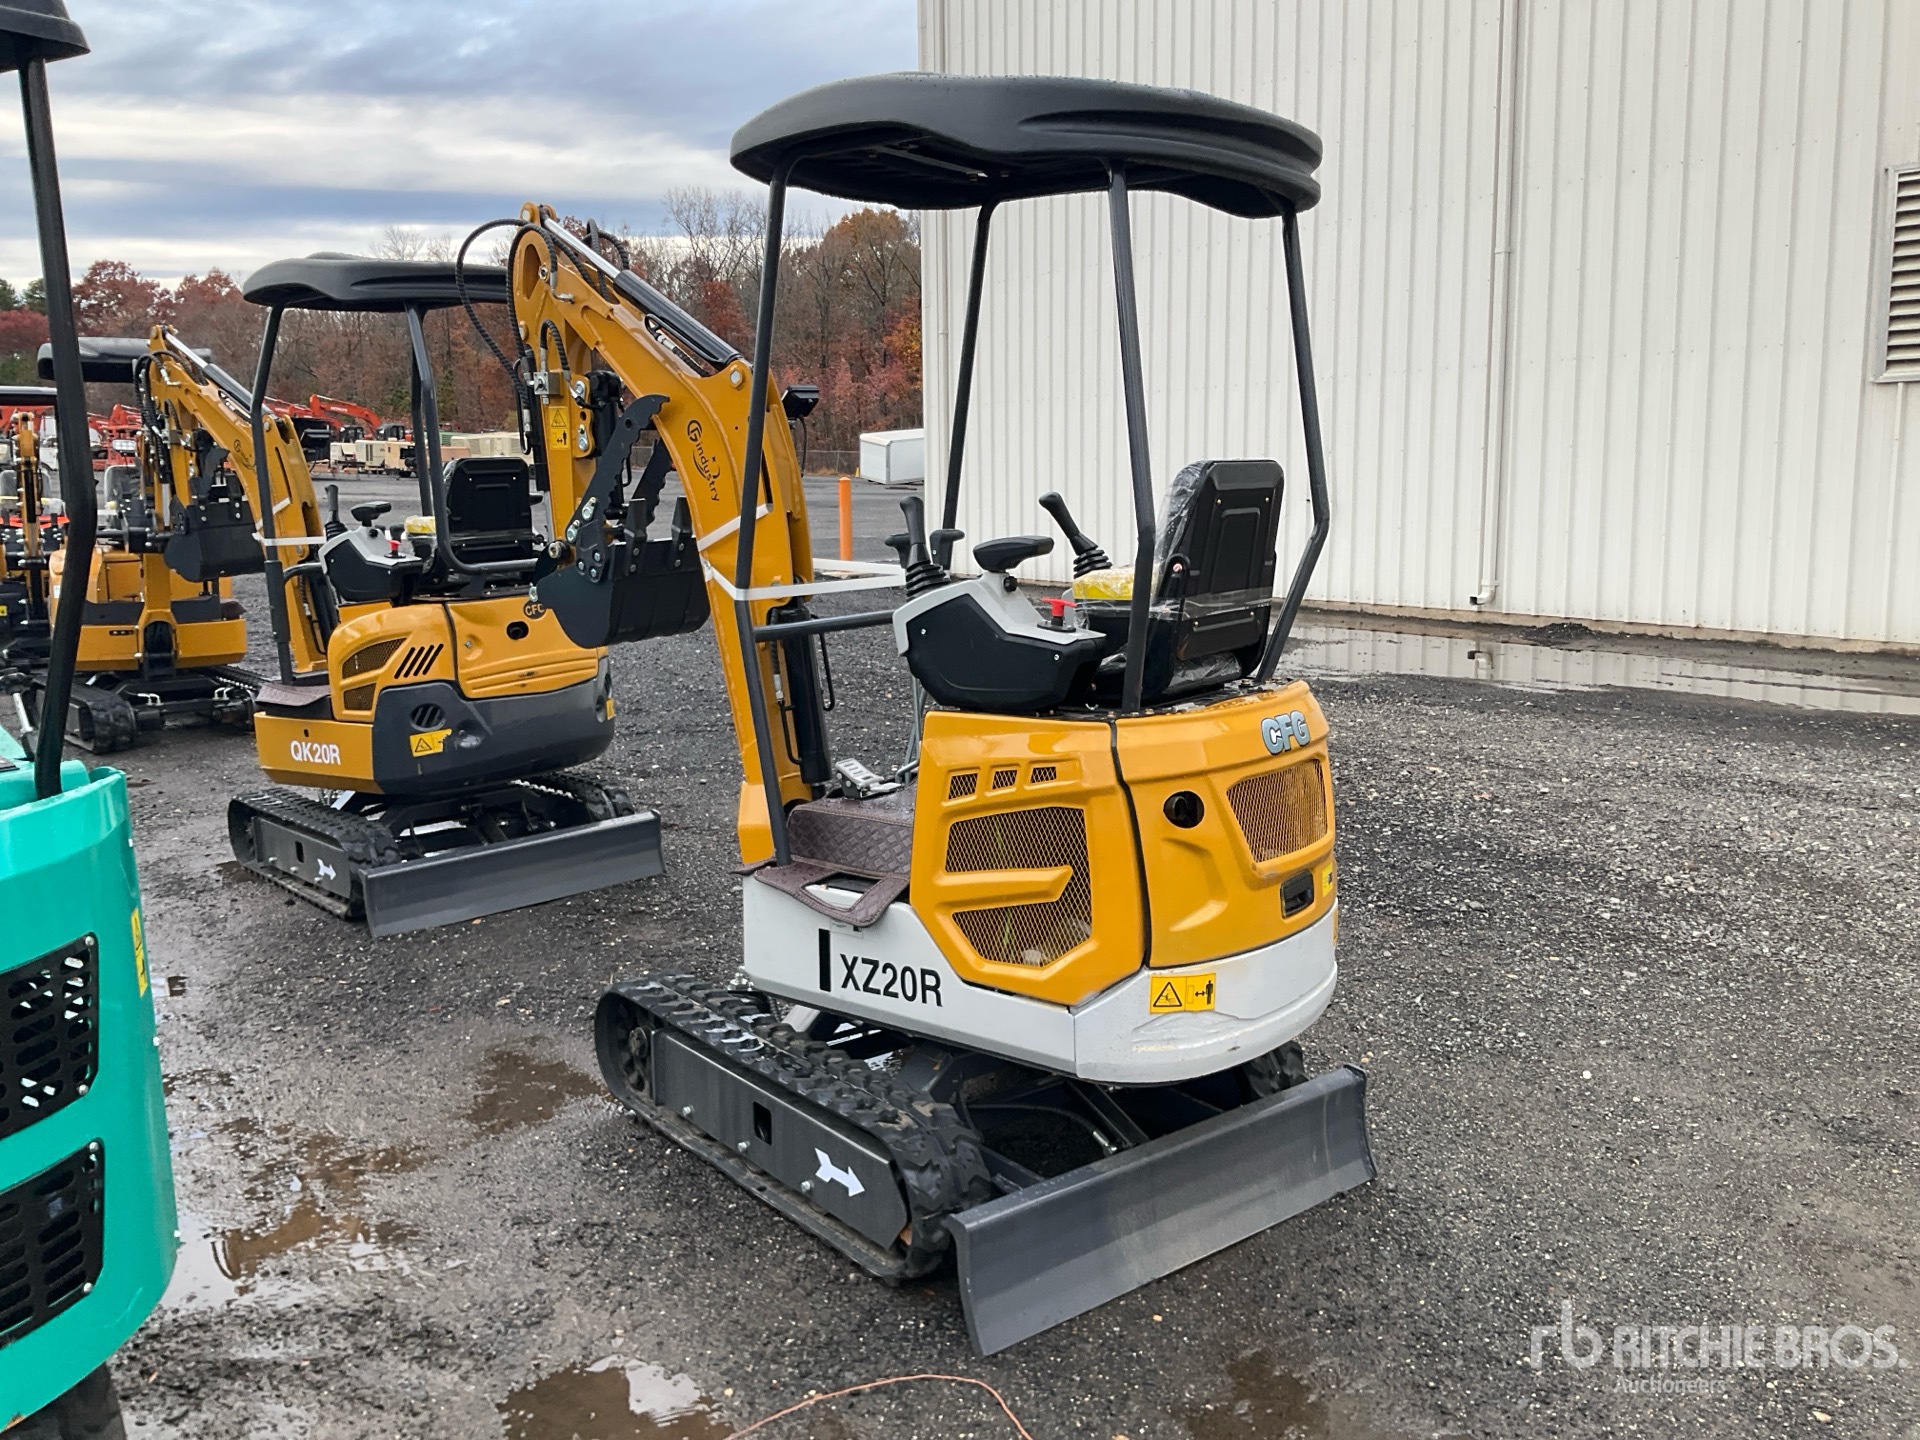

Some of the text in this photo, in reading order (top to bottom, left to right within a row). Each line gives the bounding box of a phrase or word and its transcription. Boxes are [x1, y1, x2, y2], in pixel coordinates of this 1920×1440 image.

[290, 740, 342, 766] QK20R
[1261, 709, 1311, 756] CFG
[840, 953, 943, 1007] XZ20R
